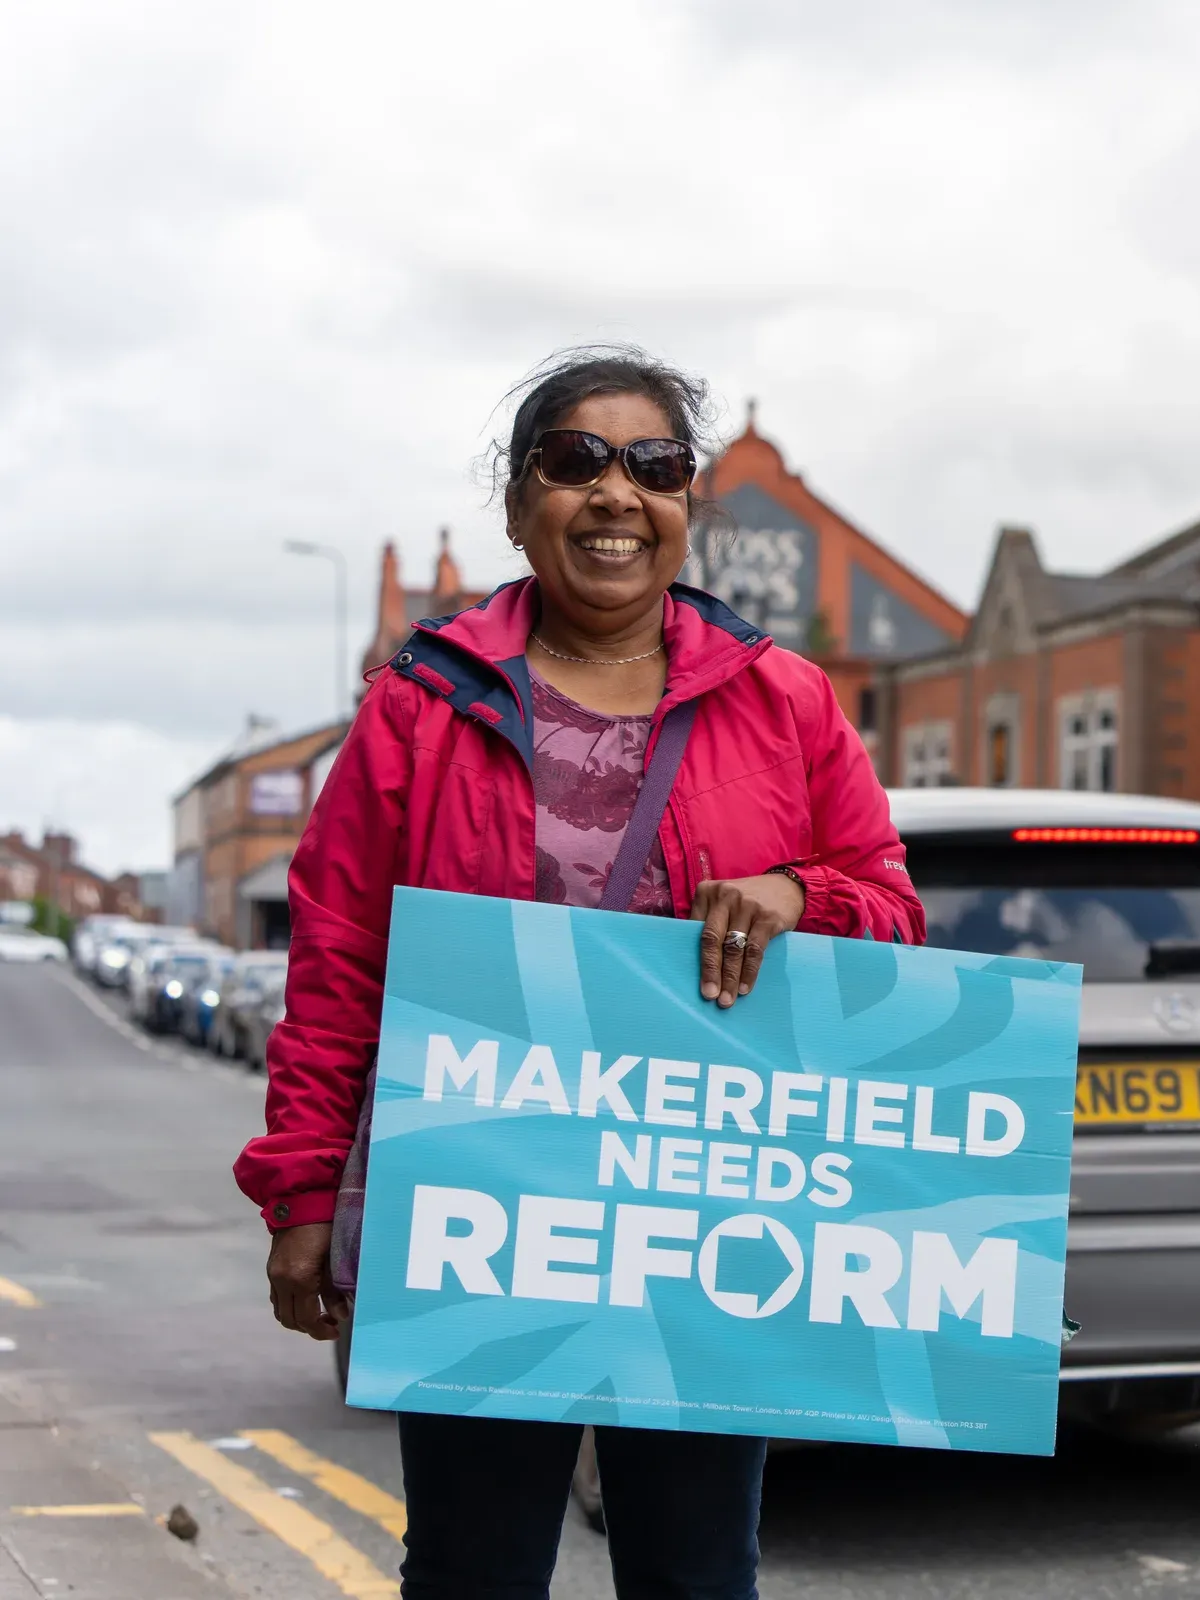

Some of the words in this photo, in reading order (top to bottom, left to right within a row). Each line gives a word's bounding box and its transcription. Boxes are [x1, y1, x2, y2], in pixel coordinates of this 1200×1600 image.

[422, 1034, 1026, 1157] MAKERFIELD
[598, 1132, 854, 1208] NEEDS
[405, 1184, 1019, 1338] REFORM
[418, 1381, 453, 1391] Promoted
[455, 1384, 464, 1392] by
[466, 1385, 487, 1393] Adam
[571, 1393, 595, 1401] Robert
[643, 1397, 651, 1405] of
[702, 1402, 731, 1411] Millbank
[755, 1406, 782, 1415] London,
[784, 1408, 803, 1416] SW1P
[821, 1411, 845, 1420] Printed
[847, 1413, 856, 1421] by
[933, 1419, 959, 1428] Preston
[960, 1421, 974, 1429] PR3
